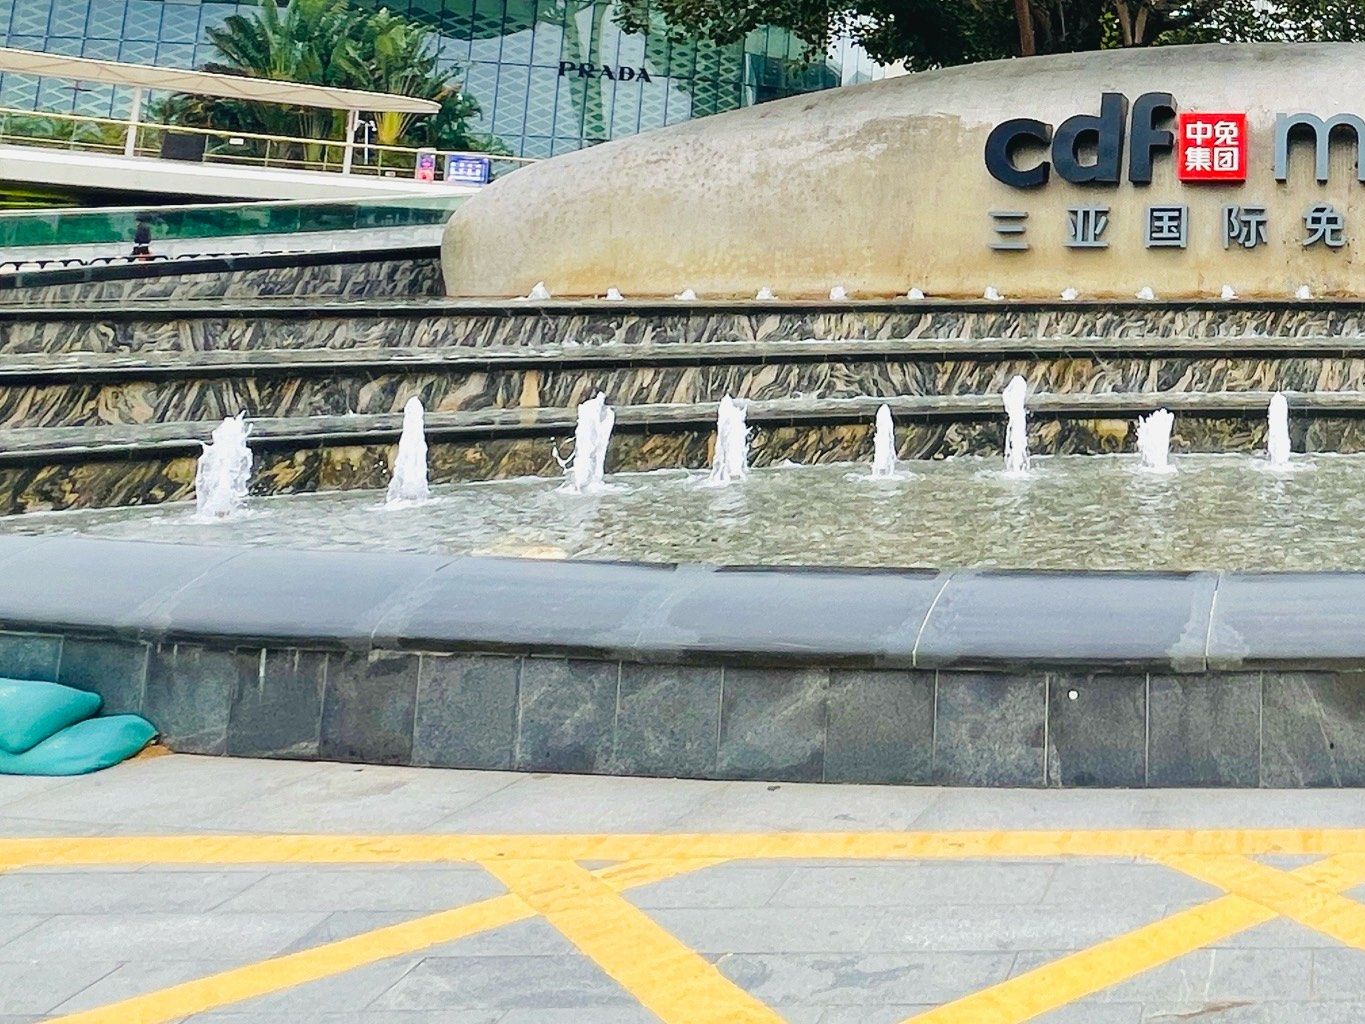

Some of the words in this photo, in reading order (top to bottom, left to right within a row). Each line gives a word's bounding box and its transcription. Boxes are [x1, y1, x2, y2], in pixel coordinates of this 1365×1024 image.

[558, 61, 652, 83] PRADA
[984, 91, 1178, 188] cdf
[1185, 120, 1240, 146] 中免
[1184, 147, 1240, 173] 集团
